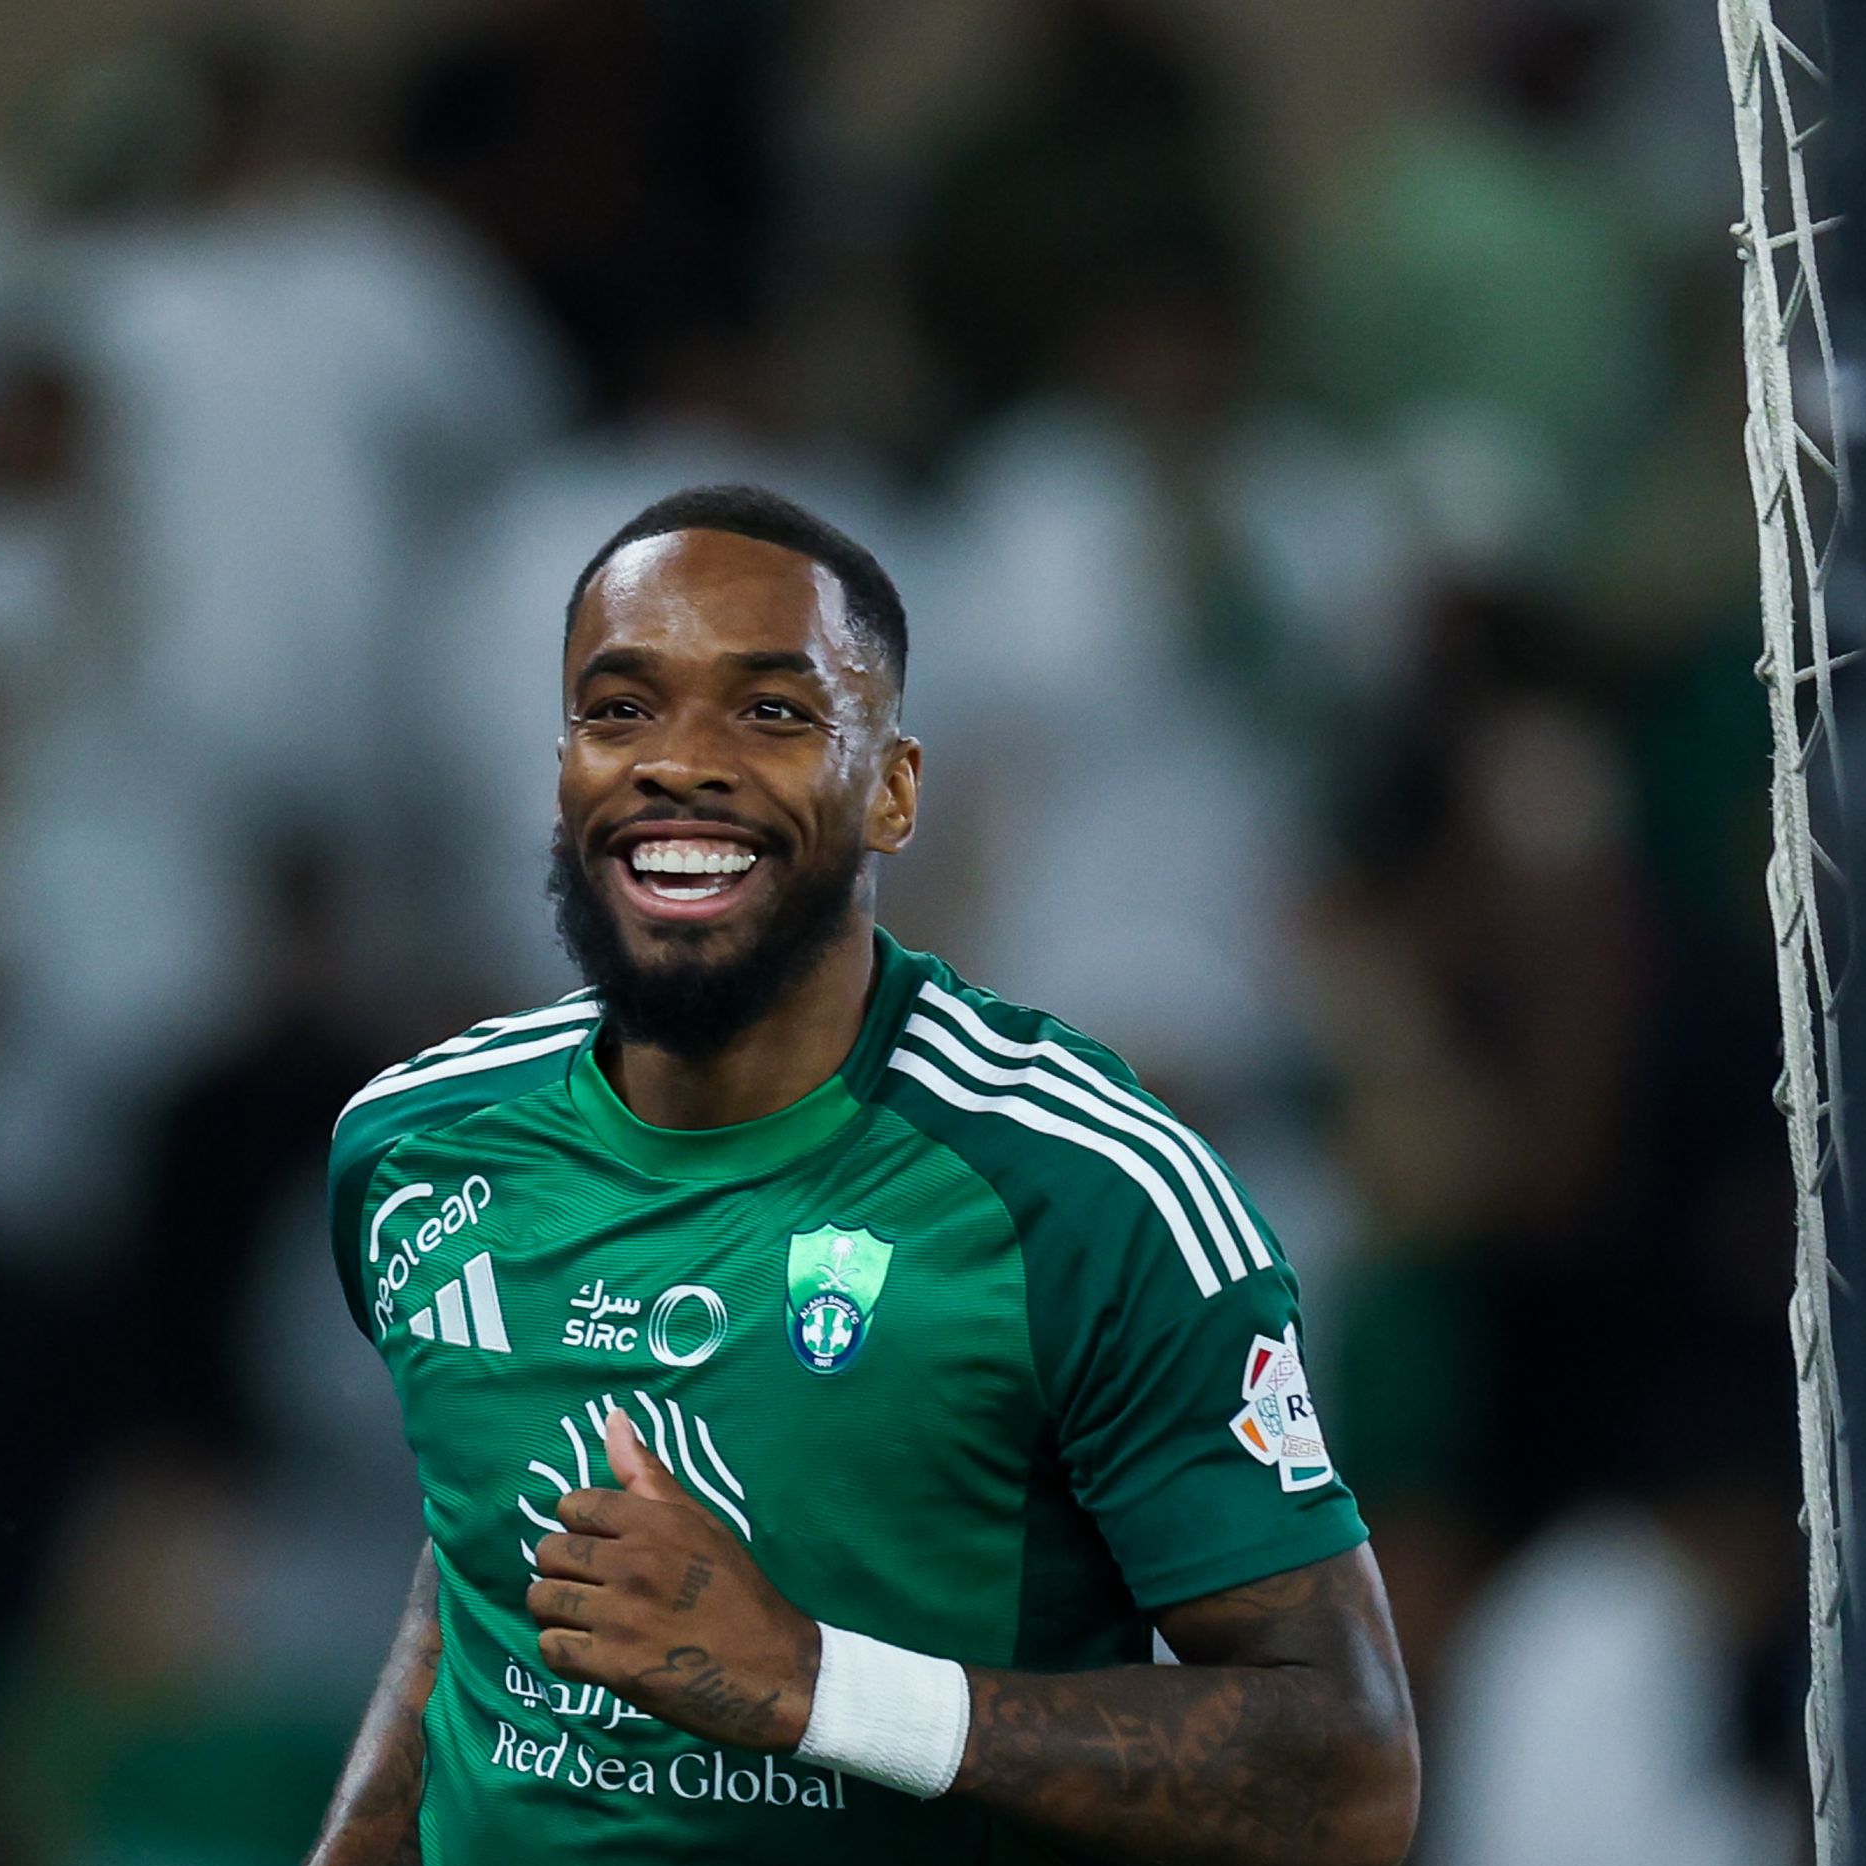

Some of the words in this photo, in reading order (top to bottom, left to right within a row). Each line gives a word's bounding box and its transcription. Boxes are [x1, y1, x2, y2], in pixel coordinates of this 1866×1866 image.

[569, 1279, 641, 1320] سرك
[562, 1318, 638, 1353] SIRC
[491, 1721, 568, 1779] Red
[567, 1743, 656, 1795] Sea
[668, 1751, 846, 1809] Global
